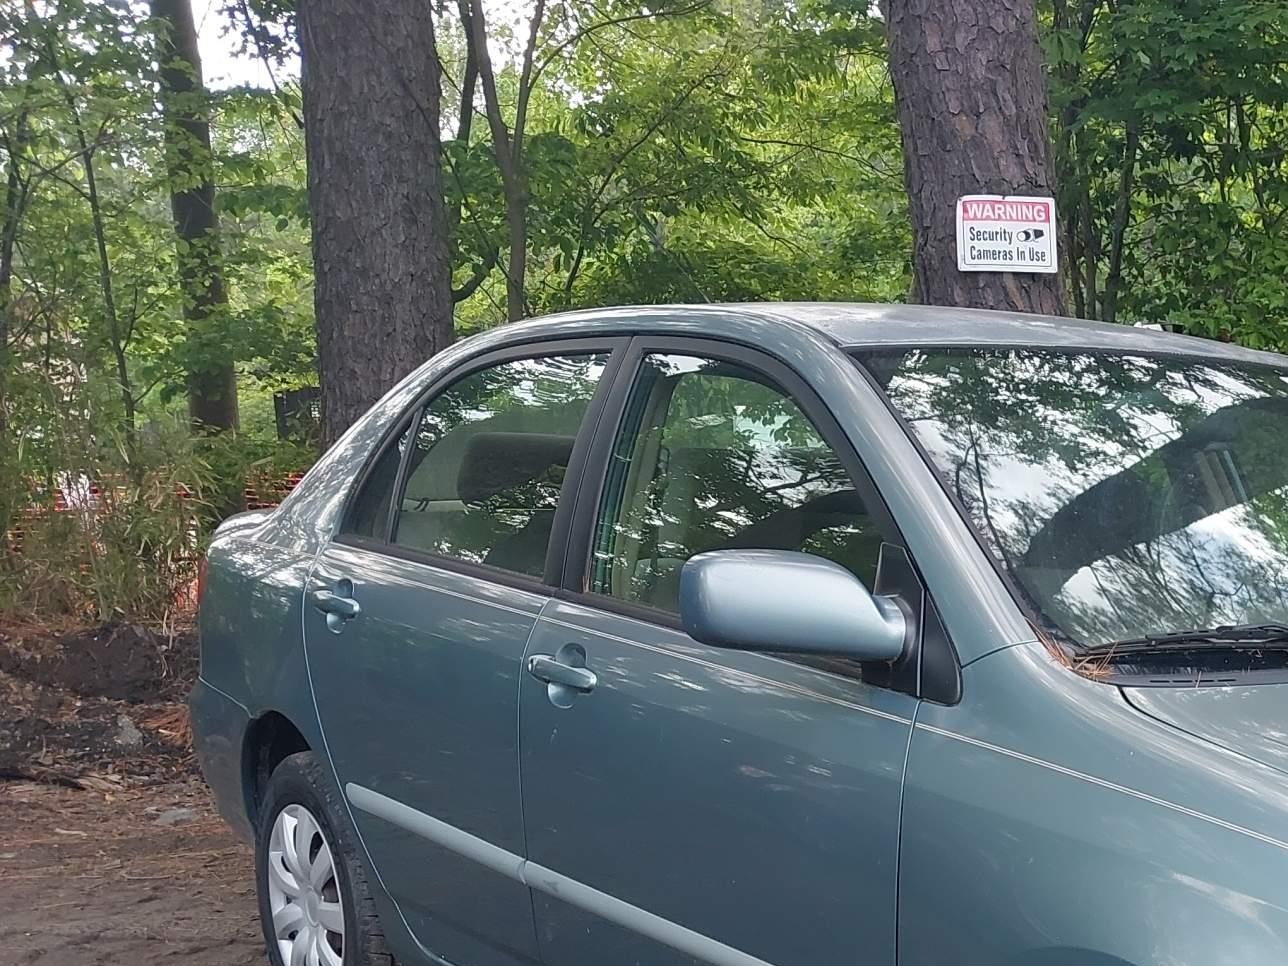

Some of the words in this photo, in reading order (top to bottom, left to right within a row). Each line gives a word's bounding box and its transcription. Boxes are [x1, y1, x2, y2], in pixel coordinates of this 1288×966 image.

[967, 203, 1046, 221] WARNING
[969, 226, 1013, 245] Security
[970, 245, 1013, 261] Cameras
[1016, 246, 1026, 261] In
[1029, 247, 1046, 262] Use
